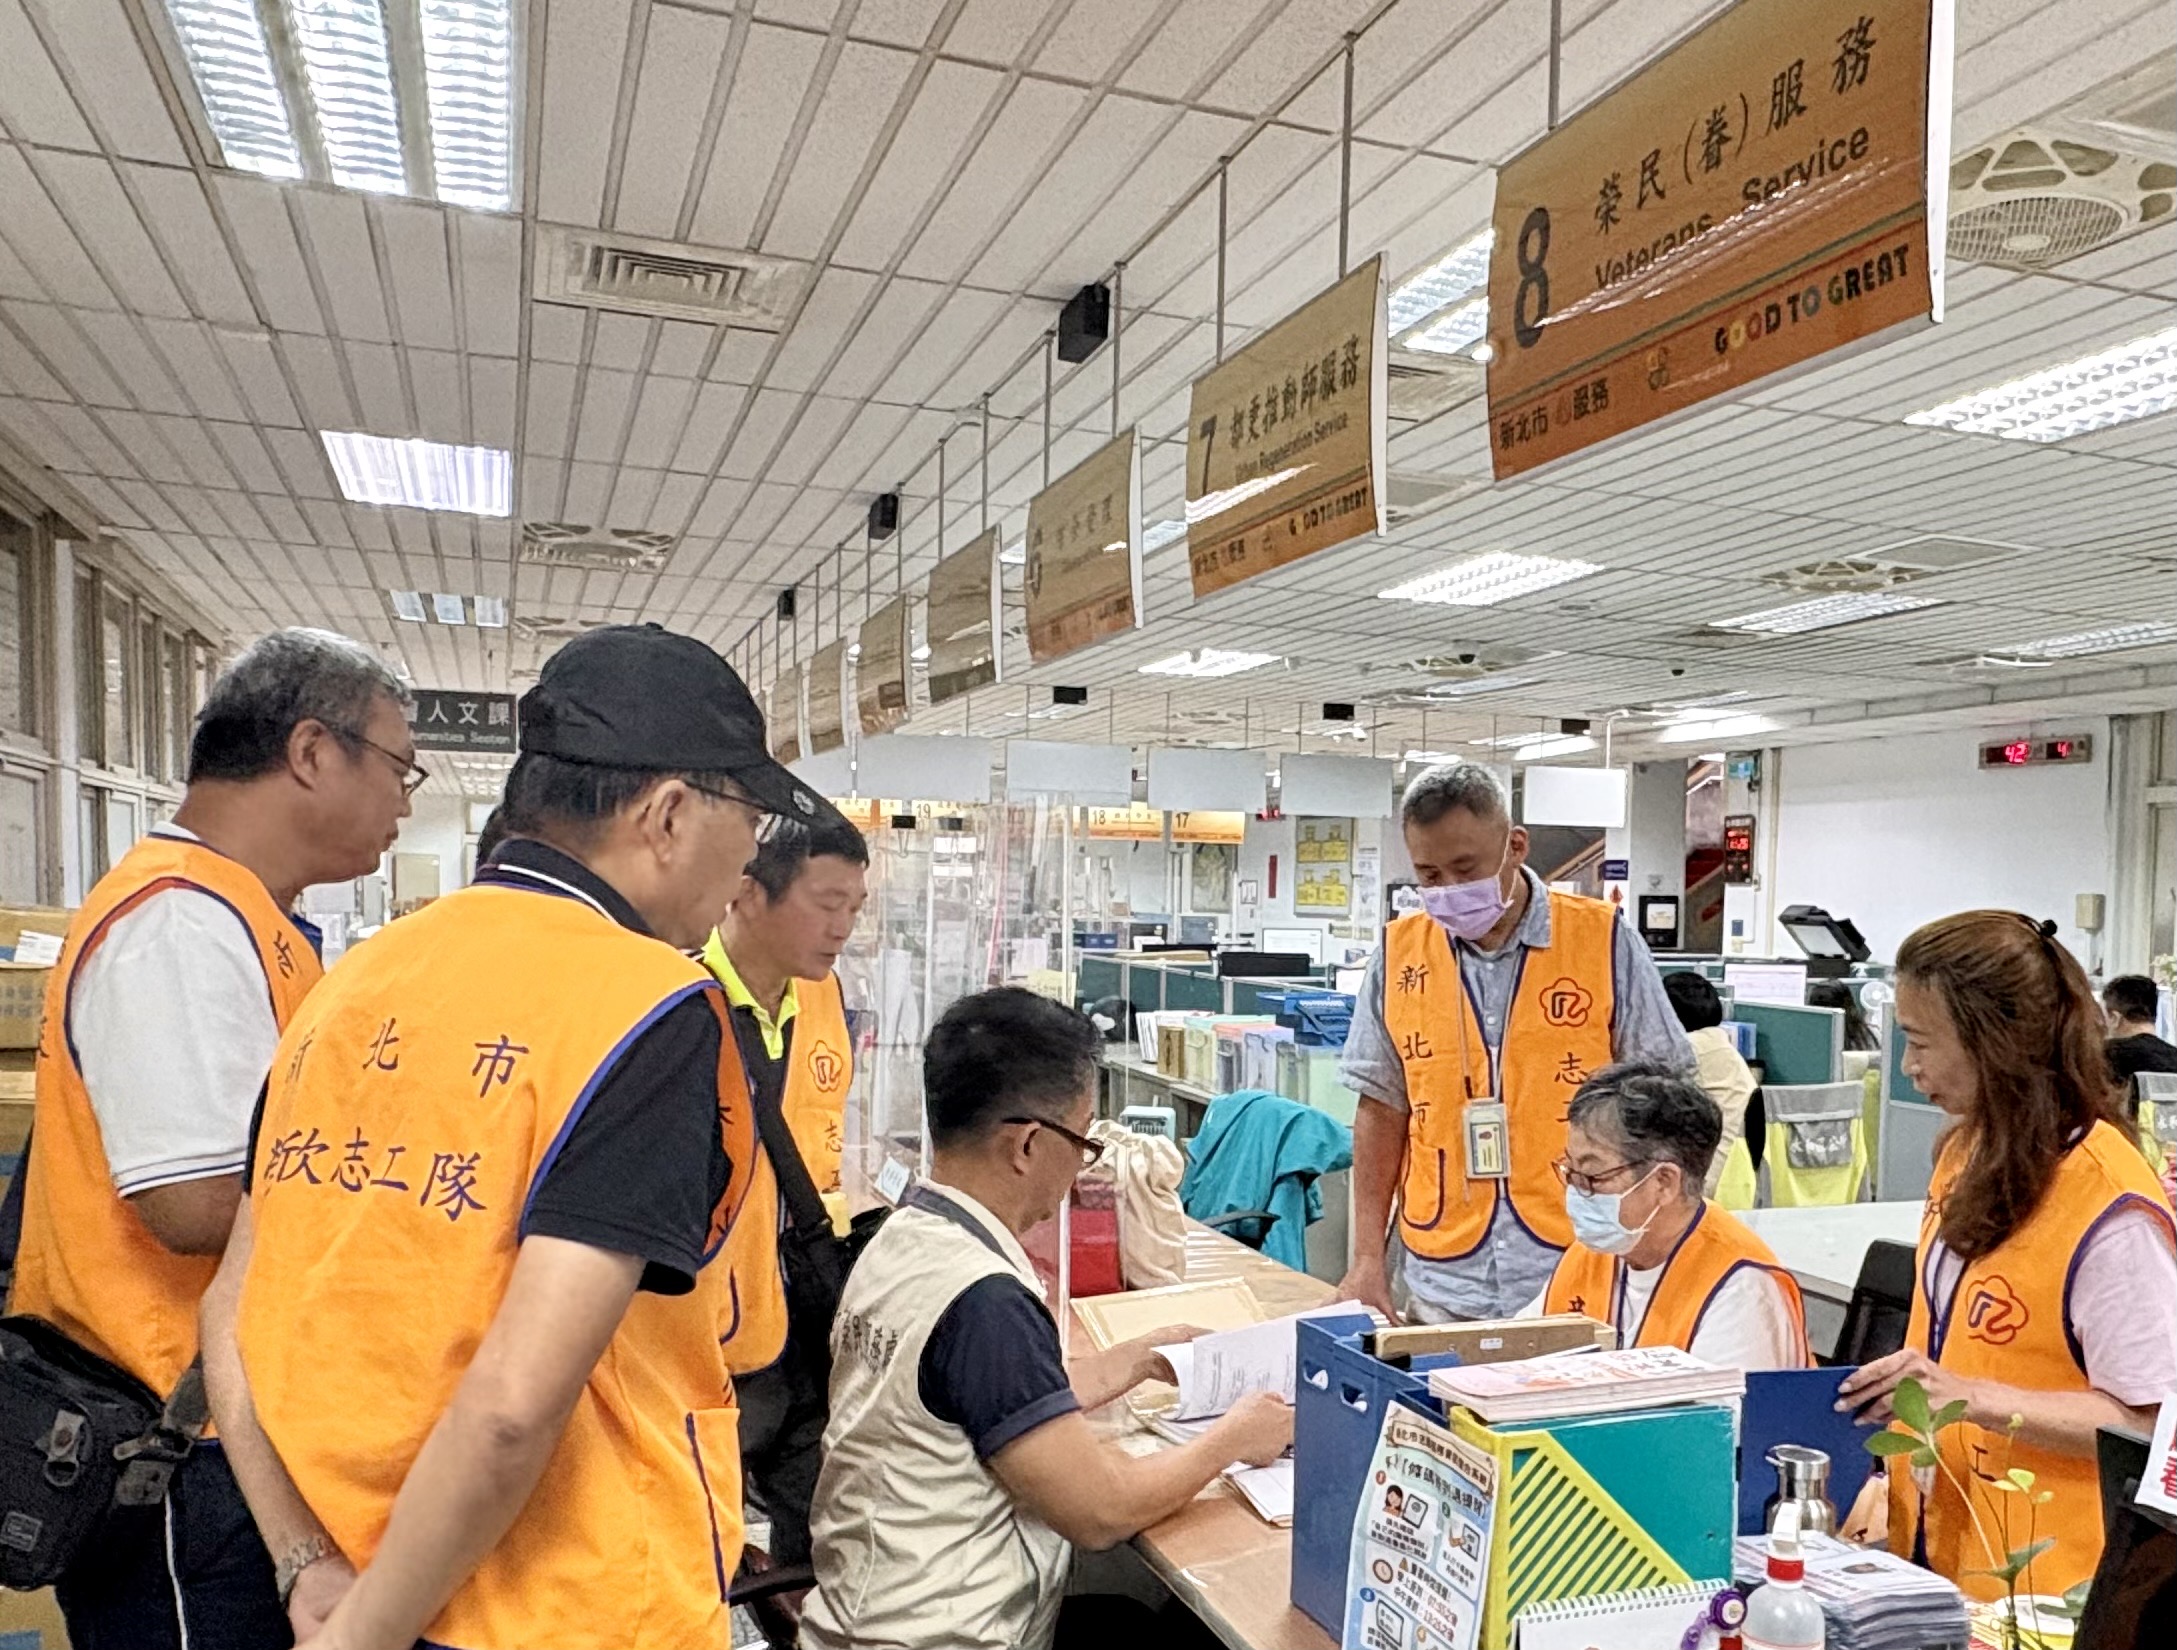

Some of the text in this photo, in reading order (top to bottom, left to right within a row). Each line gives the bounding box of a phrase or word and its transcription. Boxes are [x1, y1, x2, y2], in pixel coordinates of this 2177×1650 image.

[1595, 127, 1869, 289] Veterans Service
[1514, 207, 1550, 349] 8
[1715, 244, 1910, 355] GOOD TO GREAT
[1200, 414, 1217, 496] 7
[2004, 743, 2027, 763] 42
[916, 803, 931, 819] 19
[1093, 810, 1106, 825] 18
[1175, 812, 1190, 828] 17
